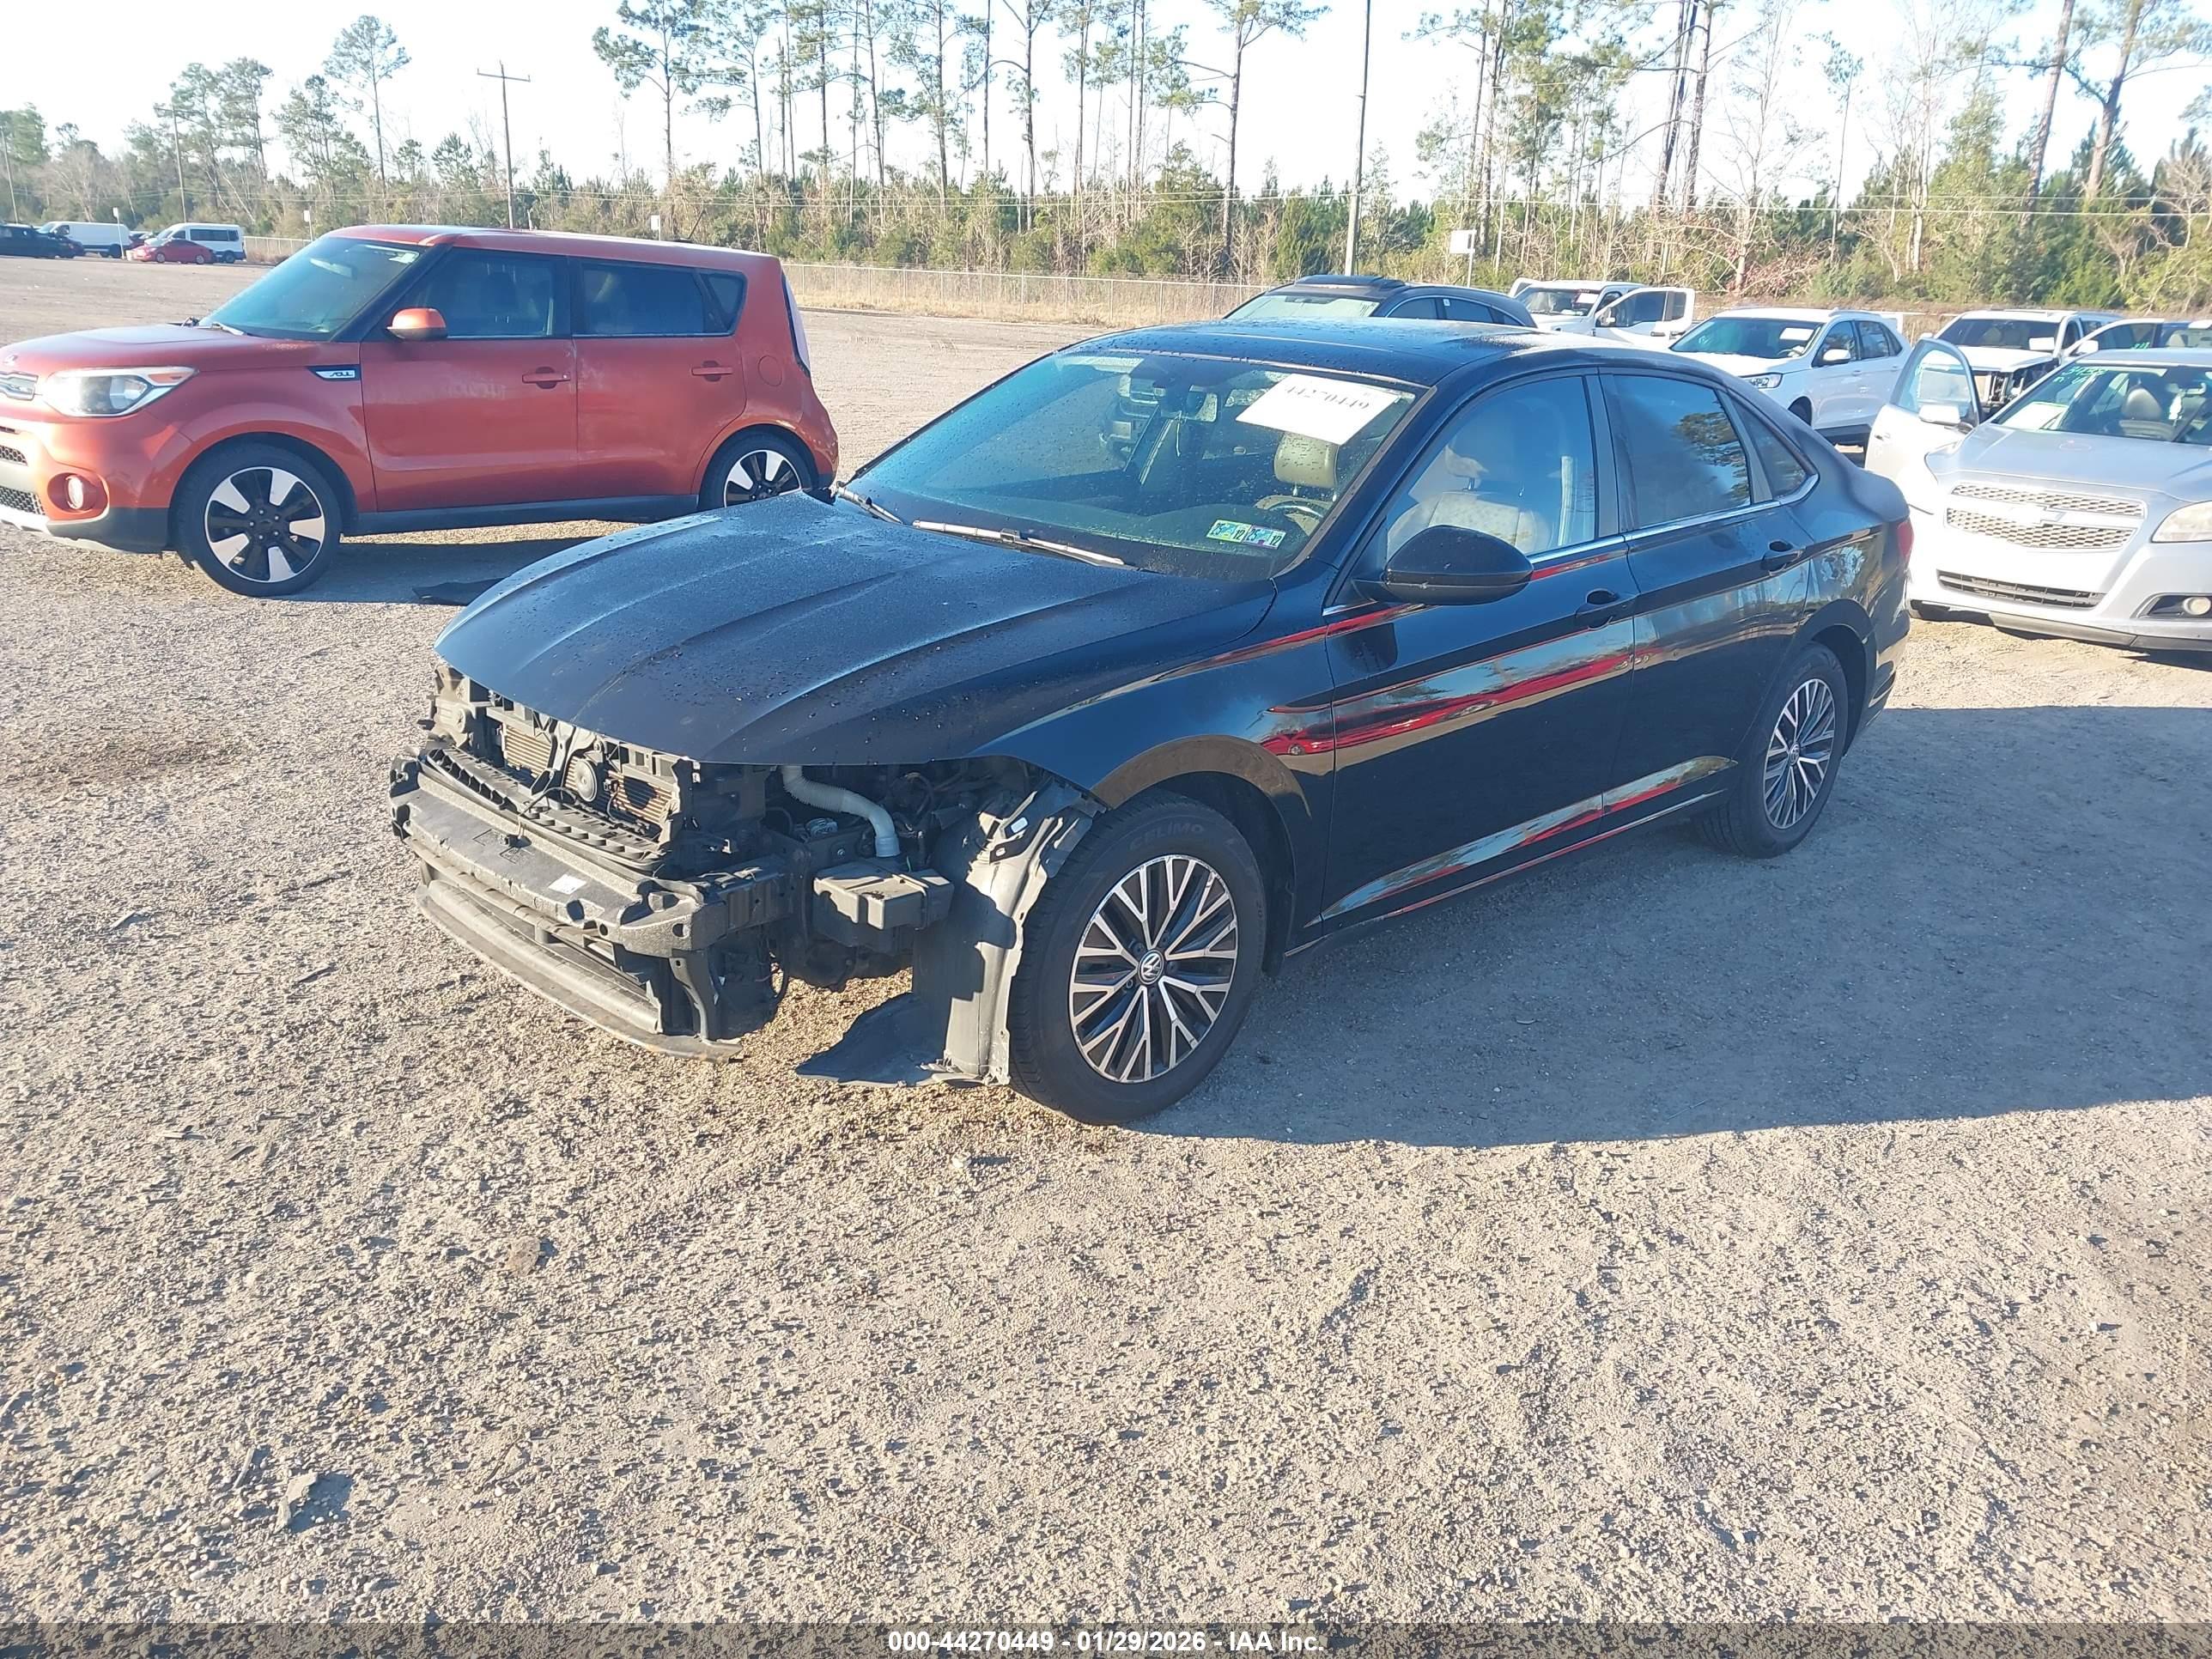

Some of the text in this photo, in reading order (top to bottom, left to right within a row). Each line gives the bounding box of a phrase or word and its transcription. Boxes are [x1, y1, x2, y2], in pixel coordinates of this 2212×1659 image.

[1210, 523, 1246, 540] 25 12
[1247, 528, 1282, 546] 25 12
